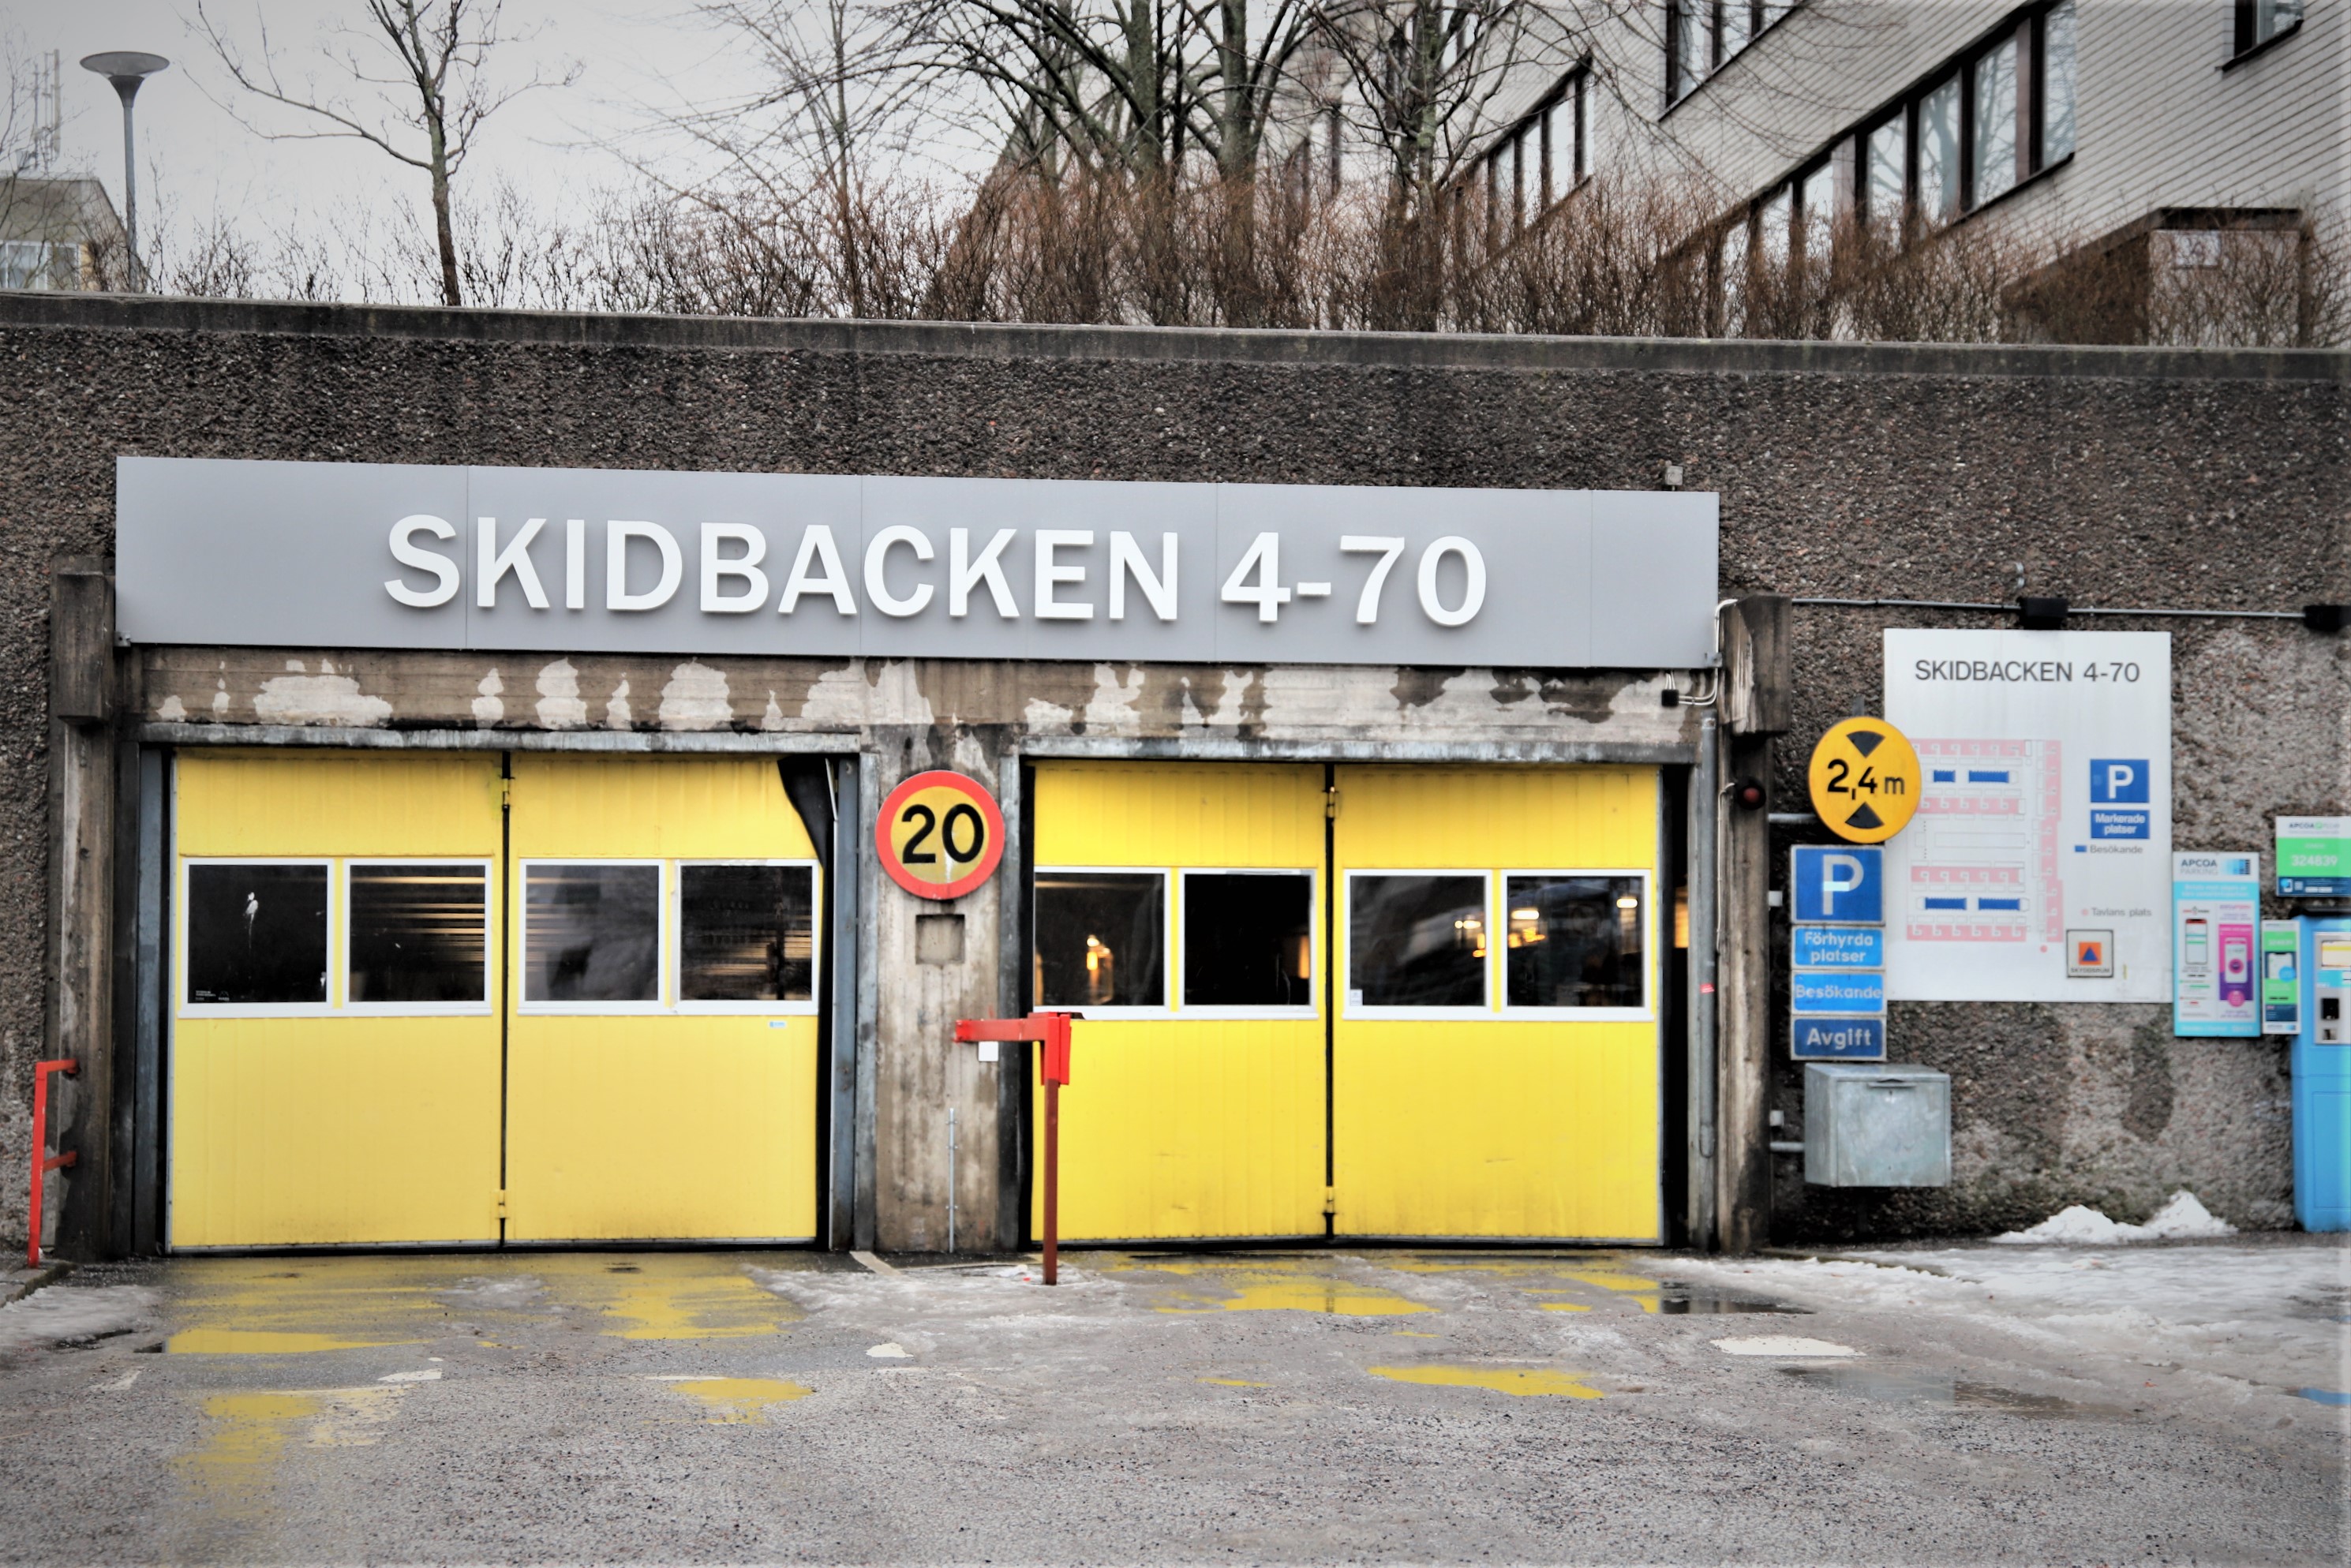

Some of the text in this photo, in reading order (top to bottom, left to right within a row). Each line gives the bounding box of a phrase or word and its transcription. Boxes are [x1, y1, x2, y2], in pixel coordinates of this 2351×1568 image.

[384, 515, 1487, 627] SKIDBACKEN 4-70
[1915, 659, 2140, 683] SKIDBACKEN 4-70
[1826, 758, 1906, 800] 2,4 m
[2107, 765, 2135, 799] P
[2095, 813, 2146, 824] Markerade
[901, 803, 985, 864] 20
[2104, 824, 2137, 836] platser
[2090, 844, 2143, 854] Besökande
[2181, 859, 2218, 867] APCOA
[2291, 854, 2338, 867] 324839
[1822, 854, 1865, 916] P
[2091, 907, 2153, 918] Tavlans plats
[1804, 931, 1874, 949] Förhyrda
[1810, 949, 1866, 964] platser
[1795, 985, 1883, 1000] Besökande
[1806, 1027, 1872, 1050] Avgift
